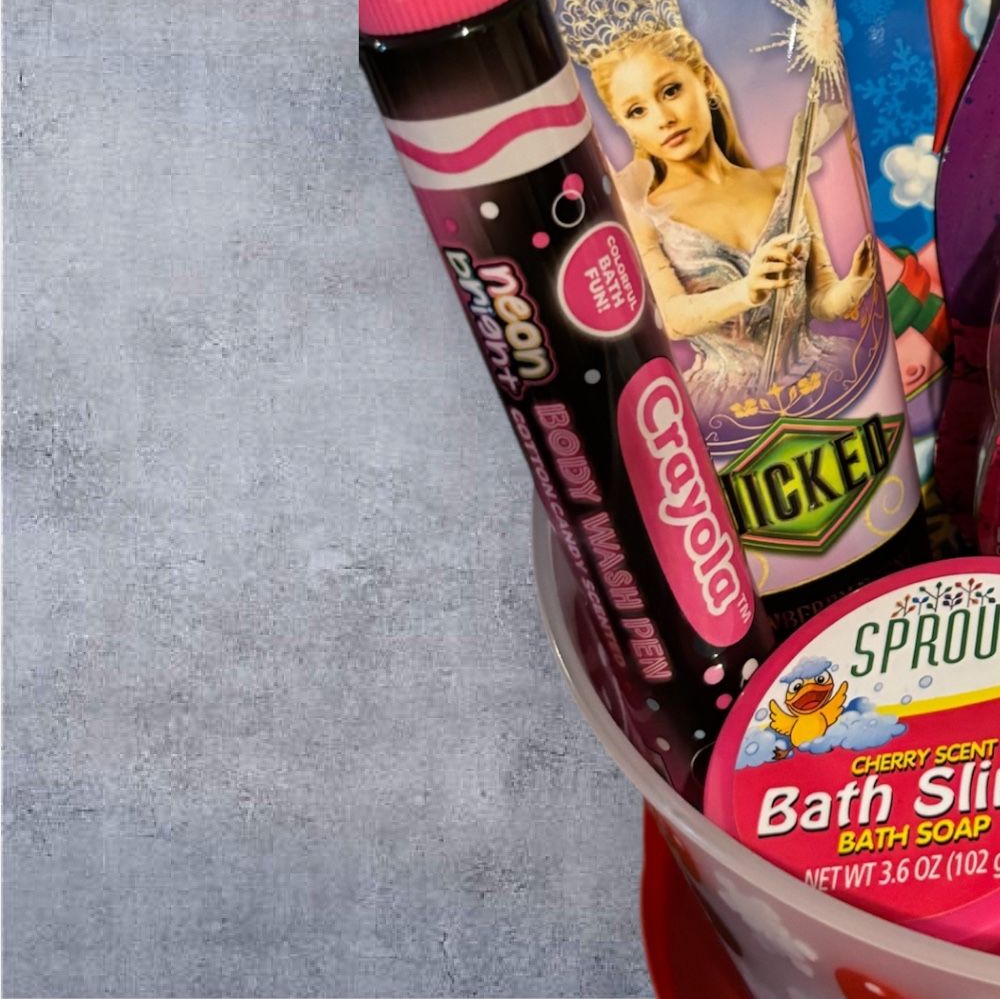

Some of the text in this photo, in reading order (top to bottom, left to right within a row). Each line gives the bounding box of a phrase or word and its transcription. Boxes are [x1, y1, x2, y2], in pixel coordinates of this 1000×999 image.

[584, 266, 611, 315] FUN!
[598, 254, 626, 309] BATH
[606, 235, 639, 312] COLORFUL
[477, 263, 551, 380] neon
[510, 407, 558, 499] COTTON
[550, 501, 588, 574] CANDY
[533, 402, 673, 681] BODY WASH PEN
[851, 738, 999, 777] CHERRY SCENT
[756, 774, 895, 838] Bath
[837, 814, 992, 857] BATH SOAP
[804, 865, 843, 892] NET
[844, 861, 878, 891] WT
[878, 859, 911, 886] 3.6
[914, 852, 944, 881] OZ
[945, 847, 990, 882] (102
